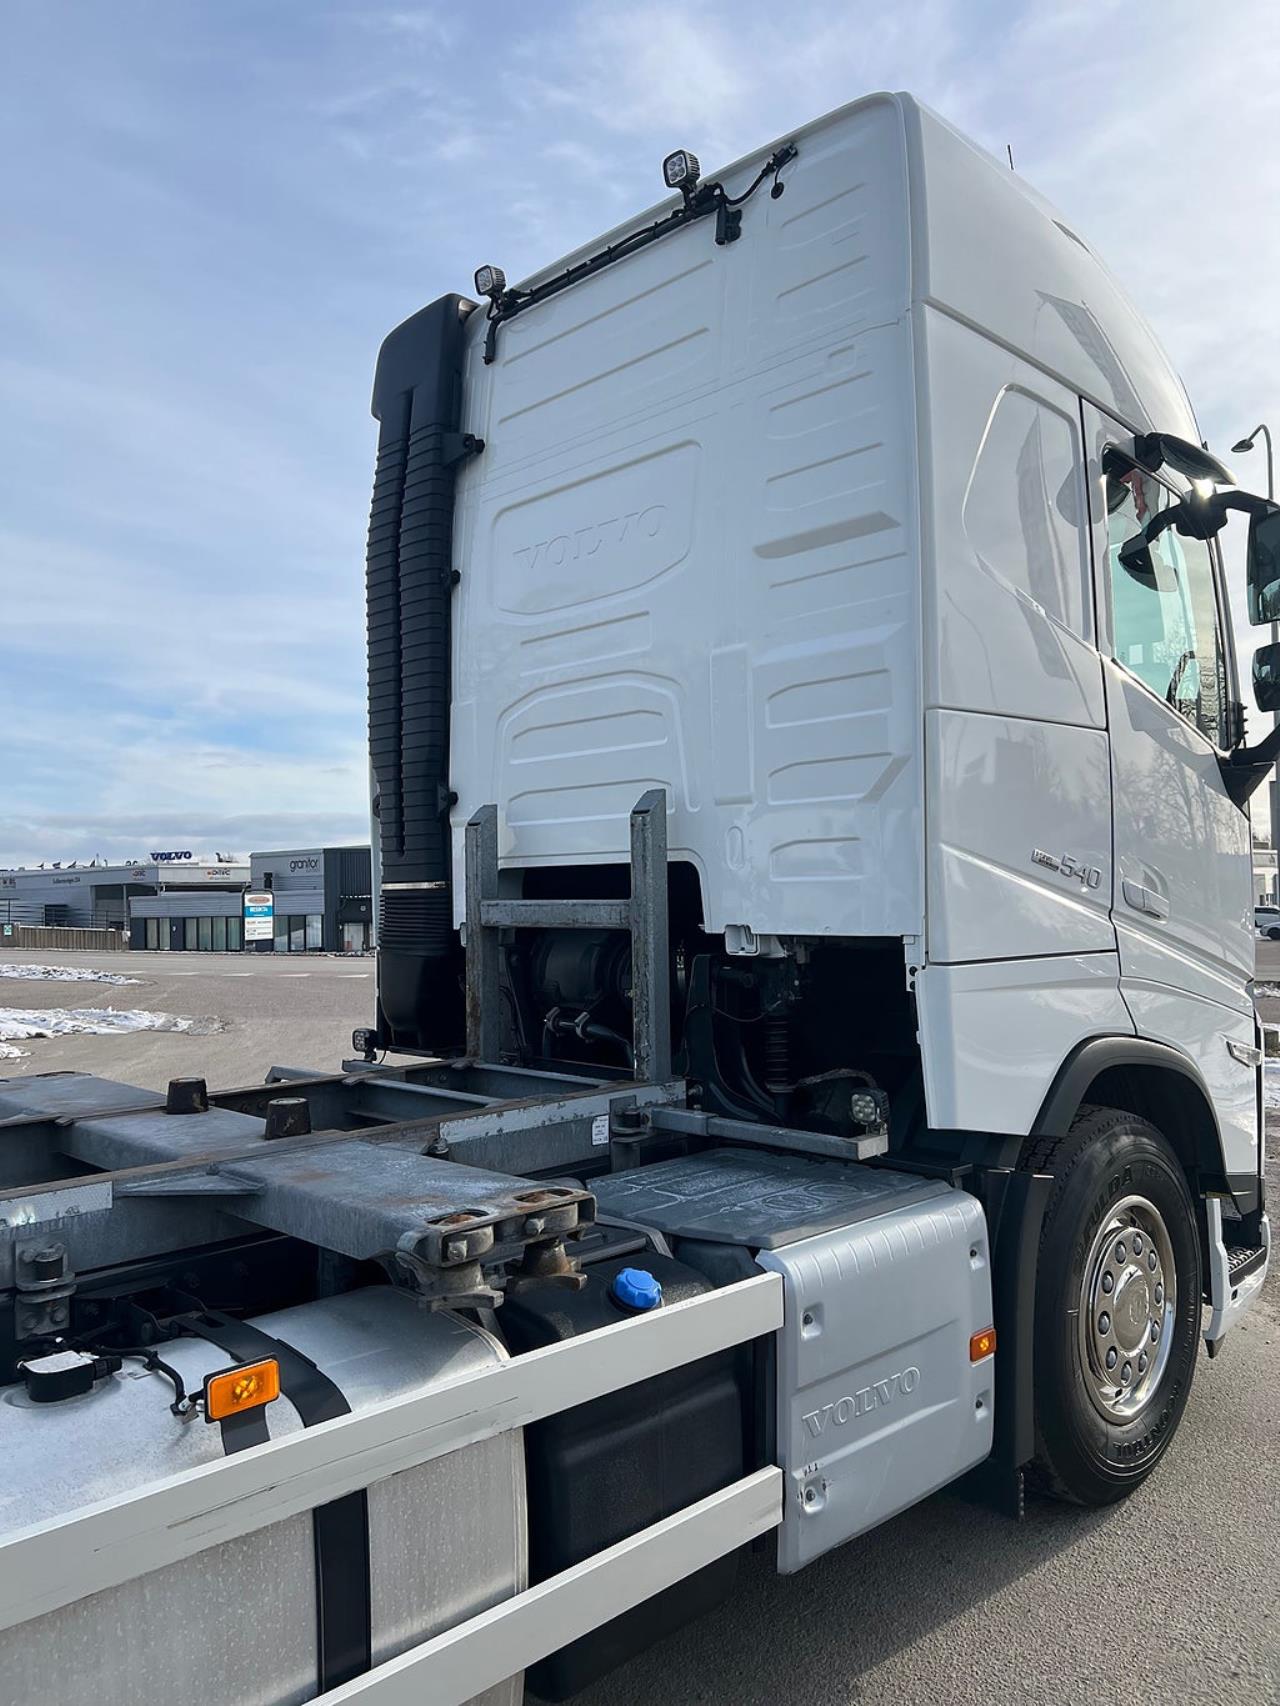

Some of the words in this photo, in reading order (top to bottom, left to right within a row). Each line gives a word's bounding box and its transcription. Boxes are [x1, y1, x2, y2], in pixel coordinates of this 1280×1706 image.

[511, 504, 667, 569] VOLVO
[150, 851, 192, 862] VOLVO
[1060, 853, 1102, 889] 540
[802, 1366, 921, 1438] VOLVO
